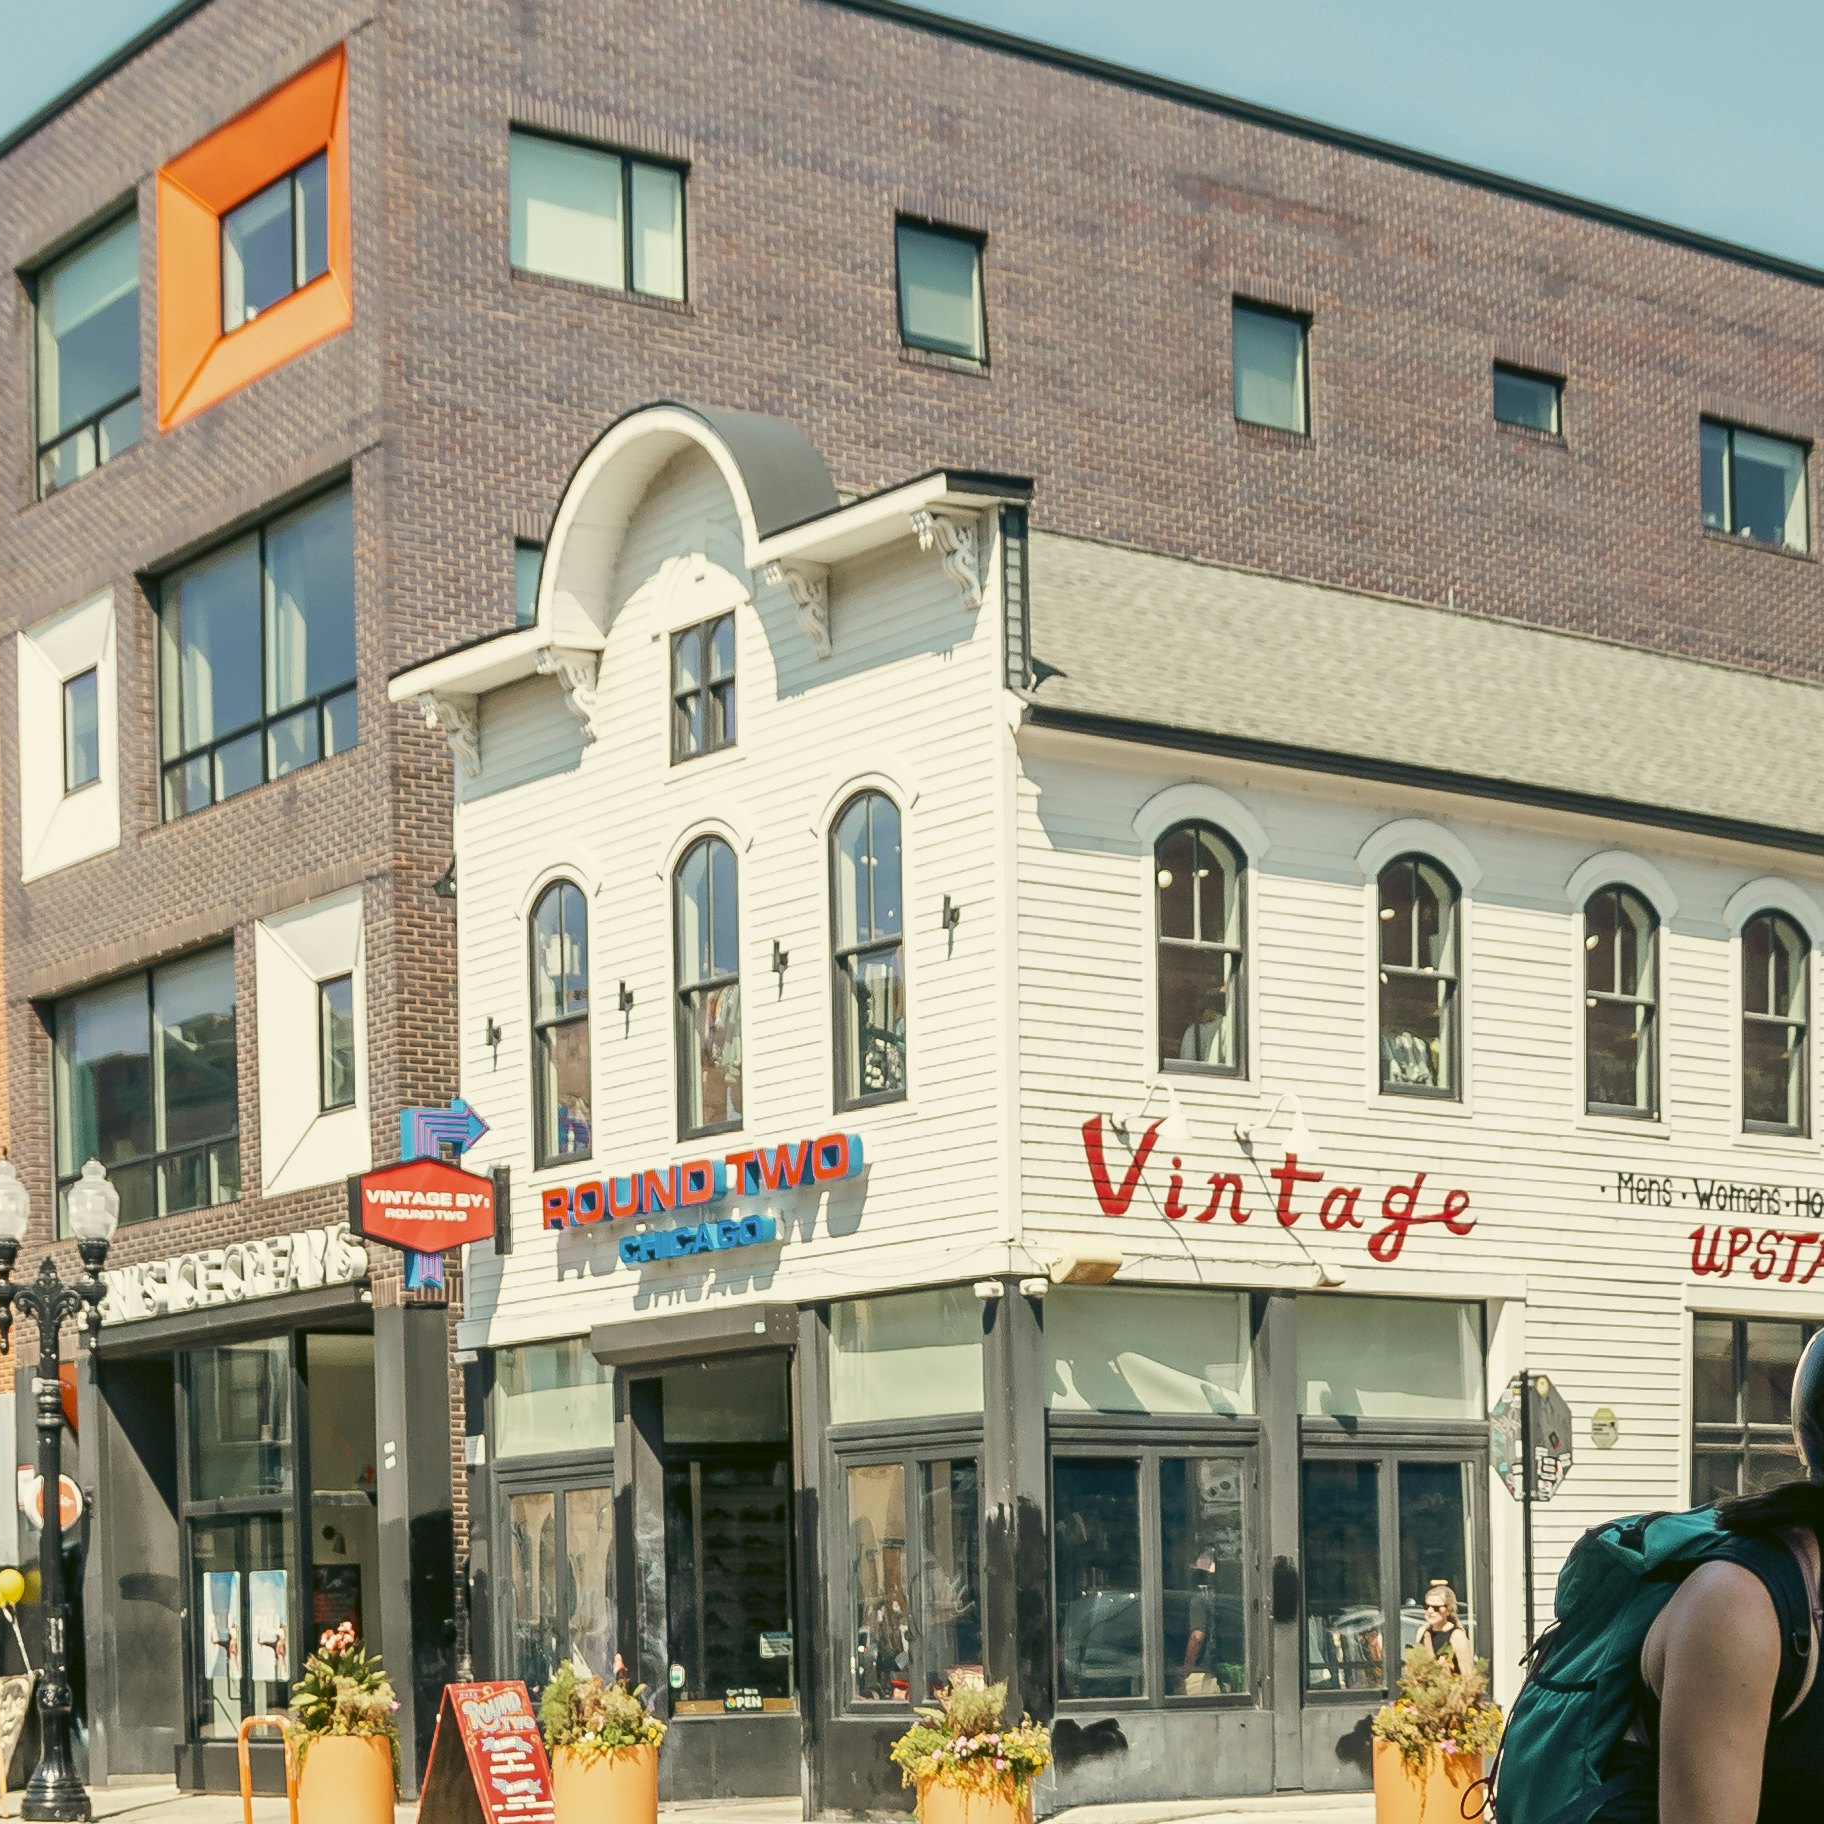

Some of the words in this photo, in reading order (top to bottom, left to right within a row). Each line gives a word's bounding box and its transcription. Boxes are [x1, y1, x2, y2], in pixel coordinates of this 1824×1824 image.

[366, 1189, 453, 1207] VINTAGE
[455, 1193, 491, 1209] BY:
[542, 1159, 719, 1230] ROUND
[725, 1132, 855, 1196] TWO
[1082, 1113, 1478, 1262] Vintage
[1617, 1172, 1672, 1207] Mens
[1691, 1177, 1781, 1215] Womens
[384, 1207, 435, 1221] ROUND
[435, 1209, 468, 1222] TWO
[618, 1215, 768, 1265] CHICAGO
[166, 1249, 226, 1313] ICE
[224, 1221, 368, 1301] CREAMS
[462, 1691, 523, 1732] ROUND
[501, 1716, 536, 1731] TWO
